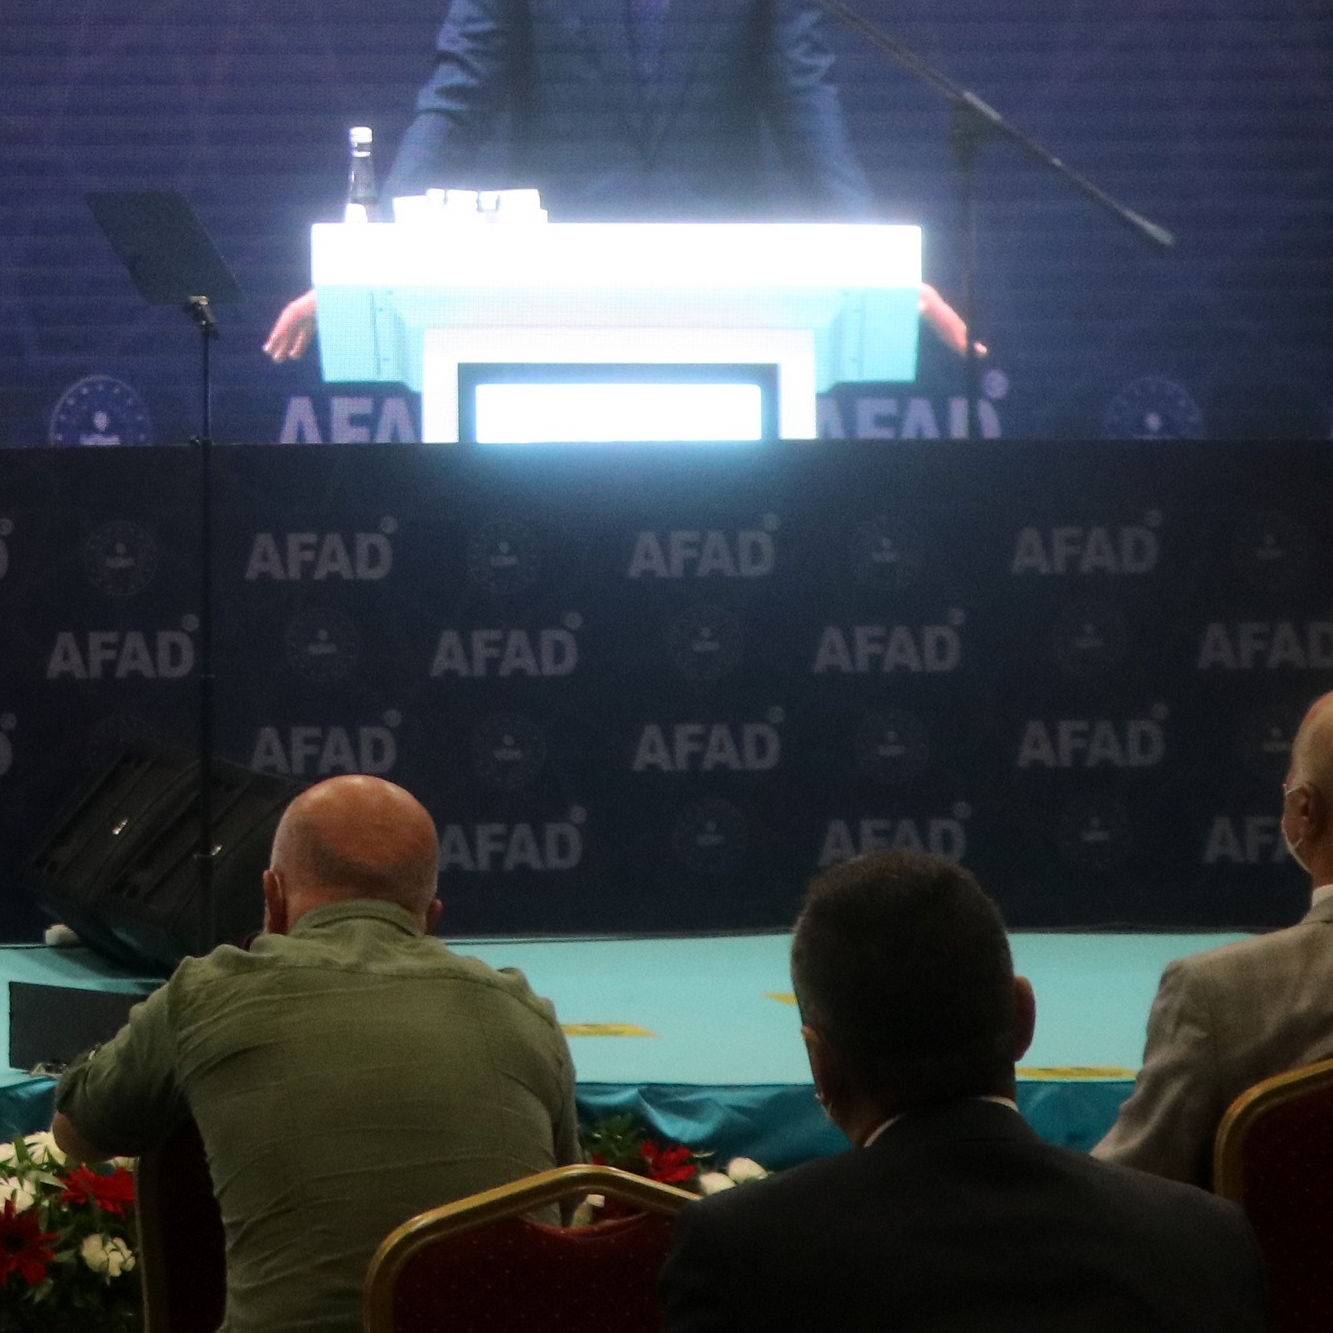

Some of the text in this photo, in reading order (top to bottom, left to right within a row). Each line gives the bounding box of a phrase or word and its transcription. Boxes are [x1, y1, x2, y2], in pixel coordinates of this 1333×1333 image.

[280, 396, 416, 443] AFA
[245, 532, 394, 581] AFAD
[628, 530, 775, 579] AFAD
[1012, 525, 1158, 575] AFAD
[46, 630, 196, 679] AFAD
[431, 629, 579, 677] AFAD
[813, 625, 960, 673] AFAD
[250, 727, 397, 776] AFAD
[633, 724, 781, 772] AFAD
[1018, 719, 1166, 768] AFAD
[439, 823, 582, 871] AFAD
